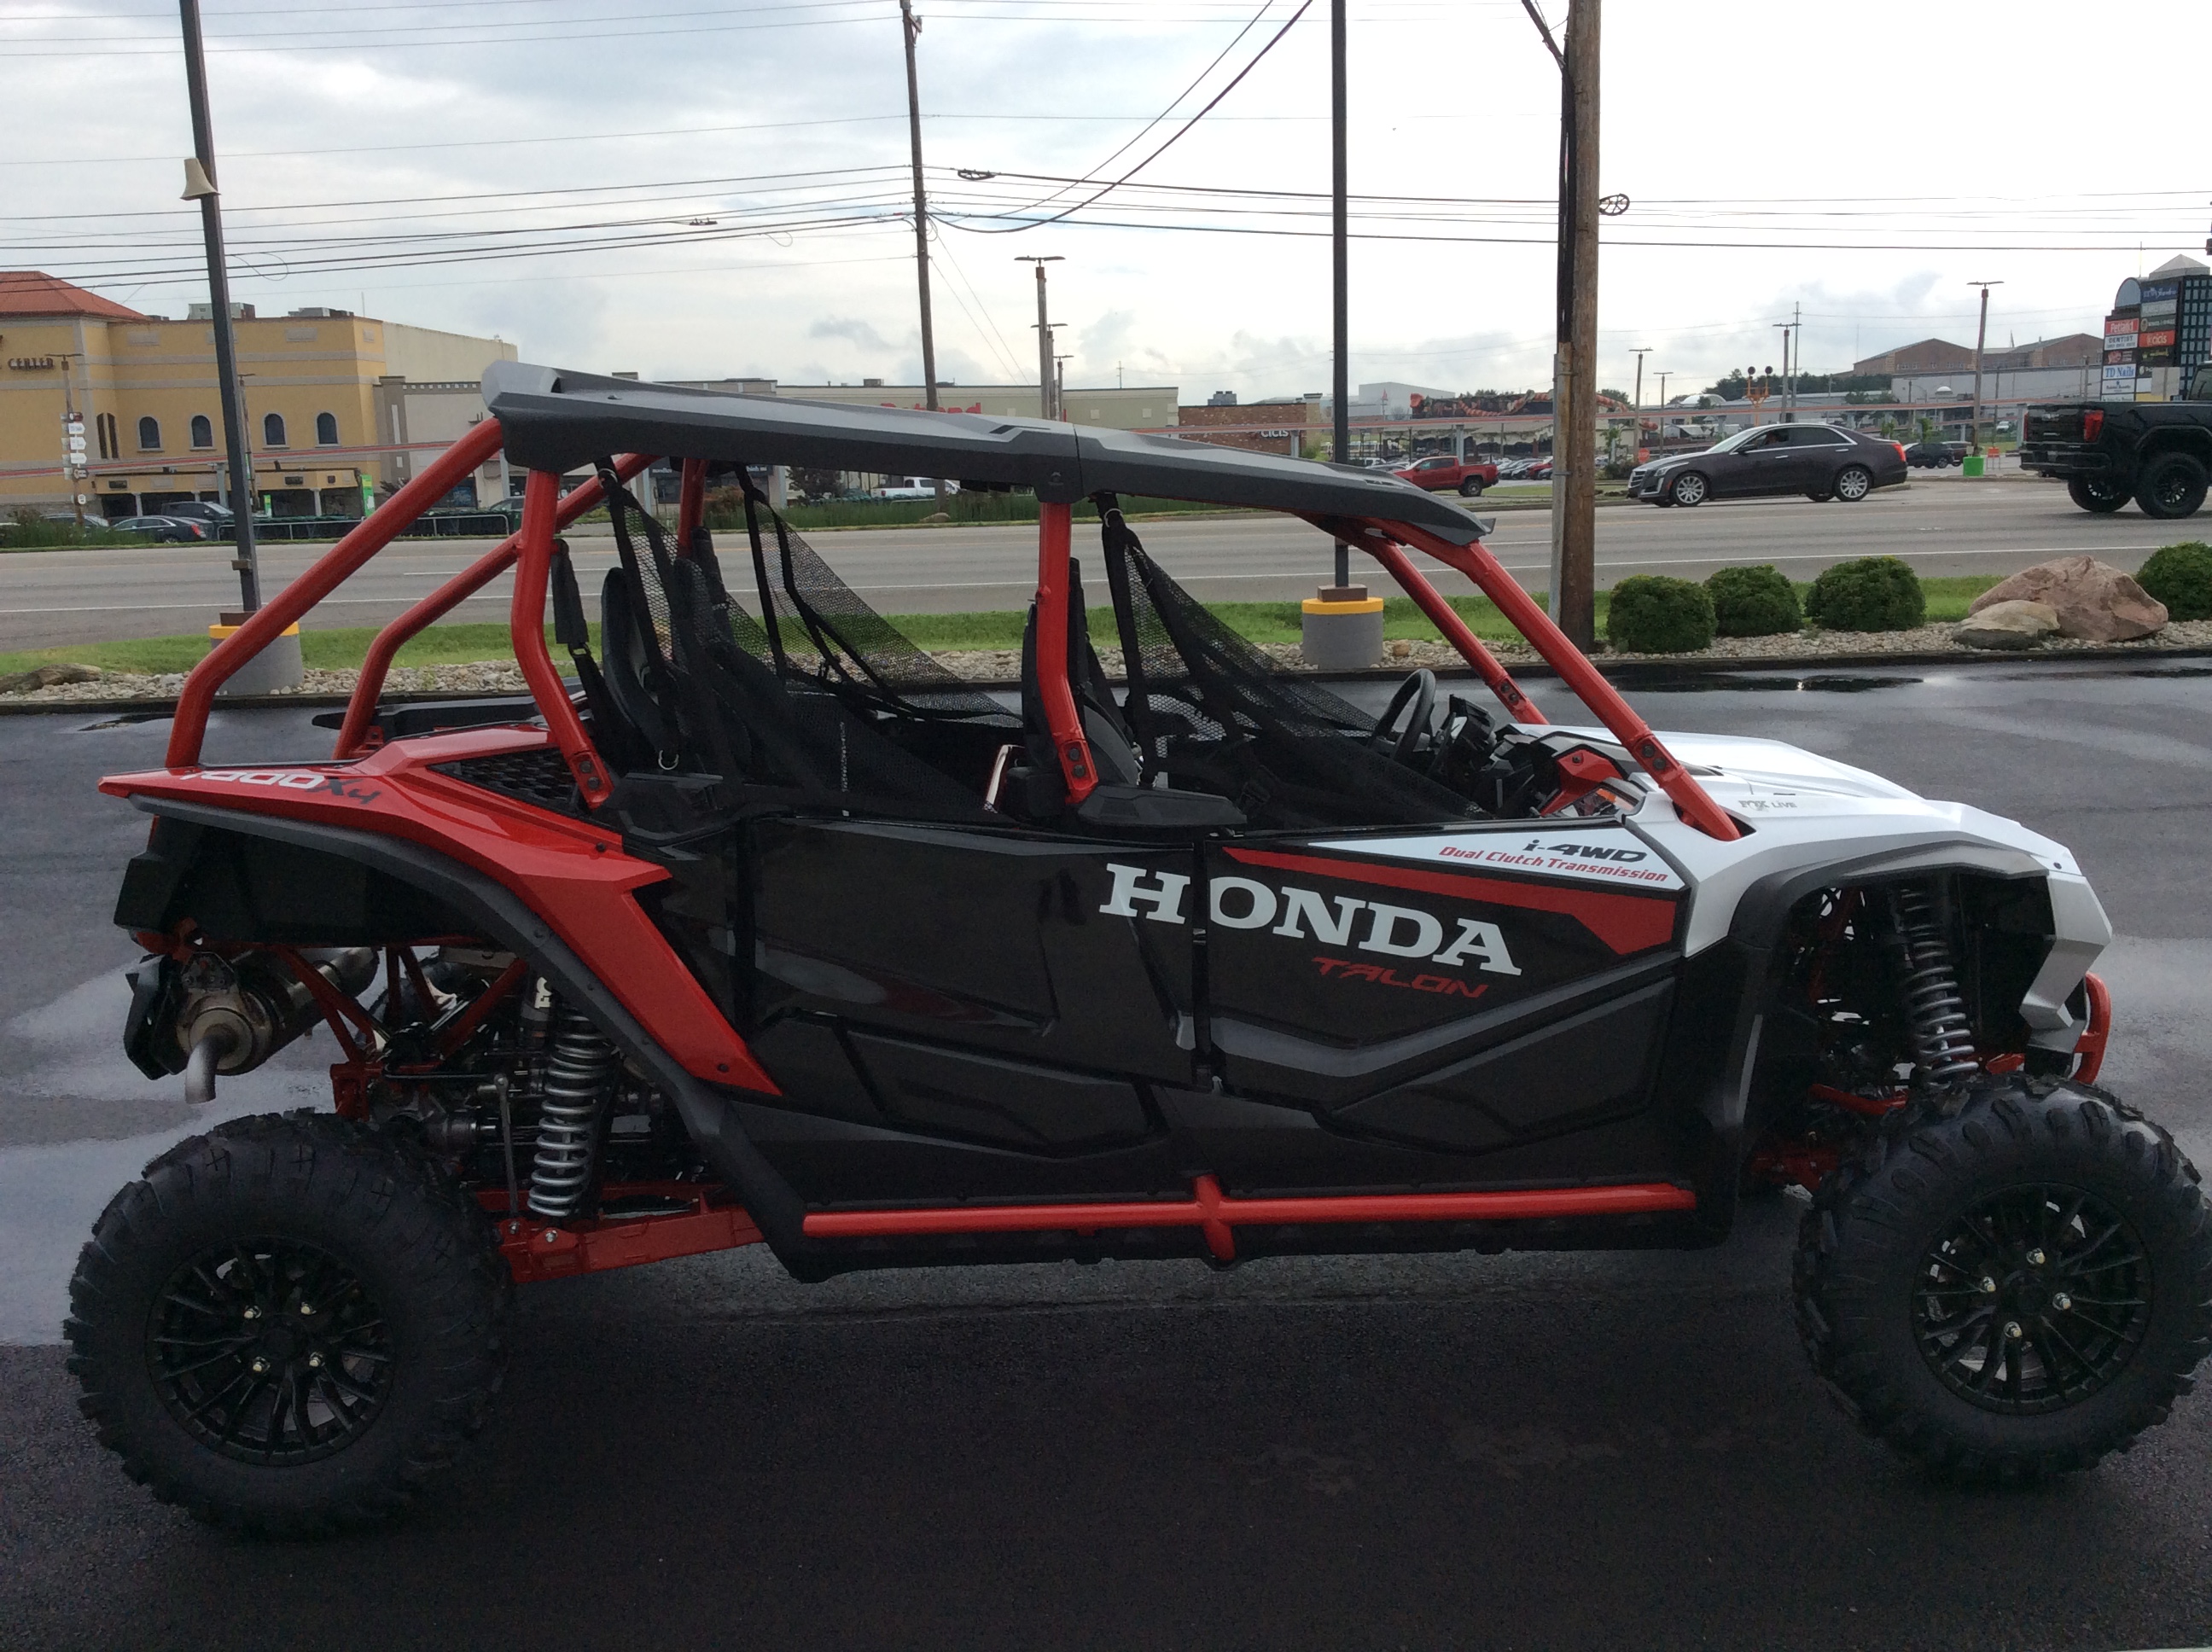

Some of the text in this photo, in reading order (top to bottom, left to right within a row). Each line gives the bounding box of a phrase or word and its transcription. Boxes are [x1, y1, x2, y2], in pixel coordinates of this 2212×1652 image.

[2110, 321, 2133, 333] Petland
[8, 358, 54, 370] CENTER
[2105, 368, 2116, 378] TD
[2117, 366, 2135, 377] Nails
[1738, 800, 1771, 811] FOX
[1522, 839, 1648, 864] i-4WD
[1438, 846, 1669, 883] Dual Clutch Transmission
[1099, 863, 1522, 976] HONDA
[1313, 957, 1489, 998] TALON
